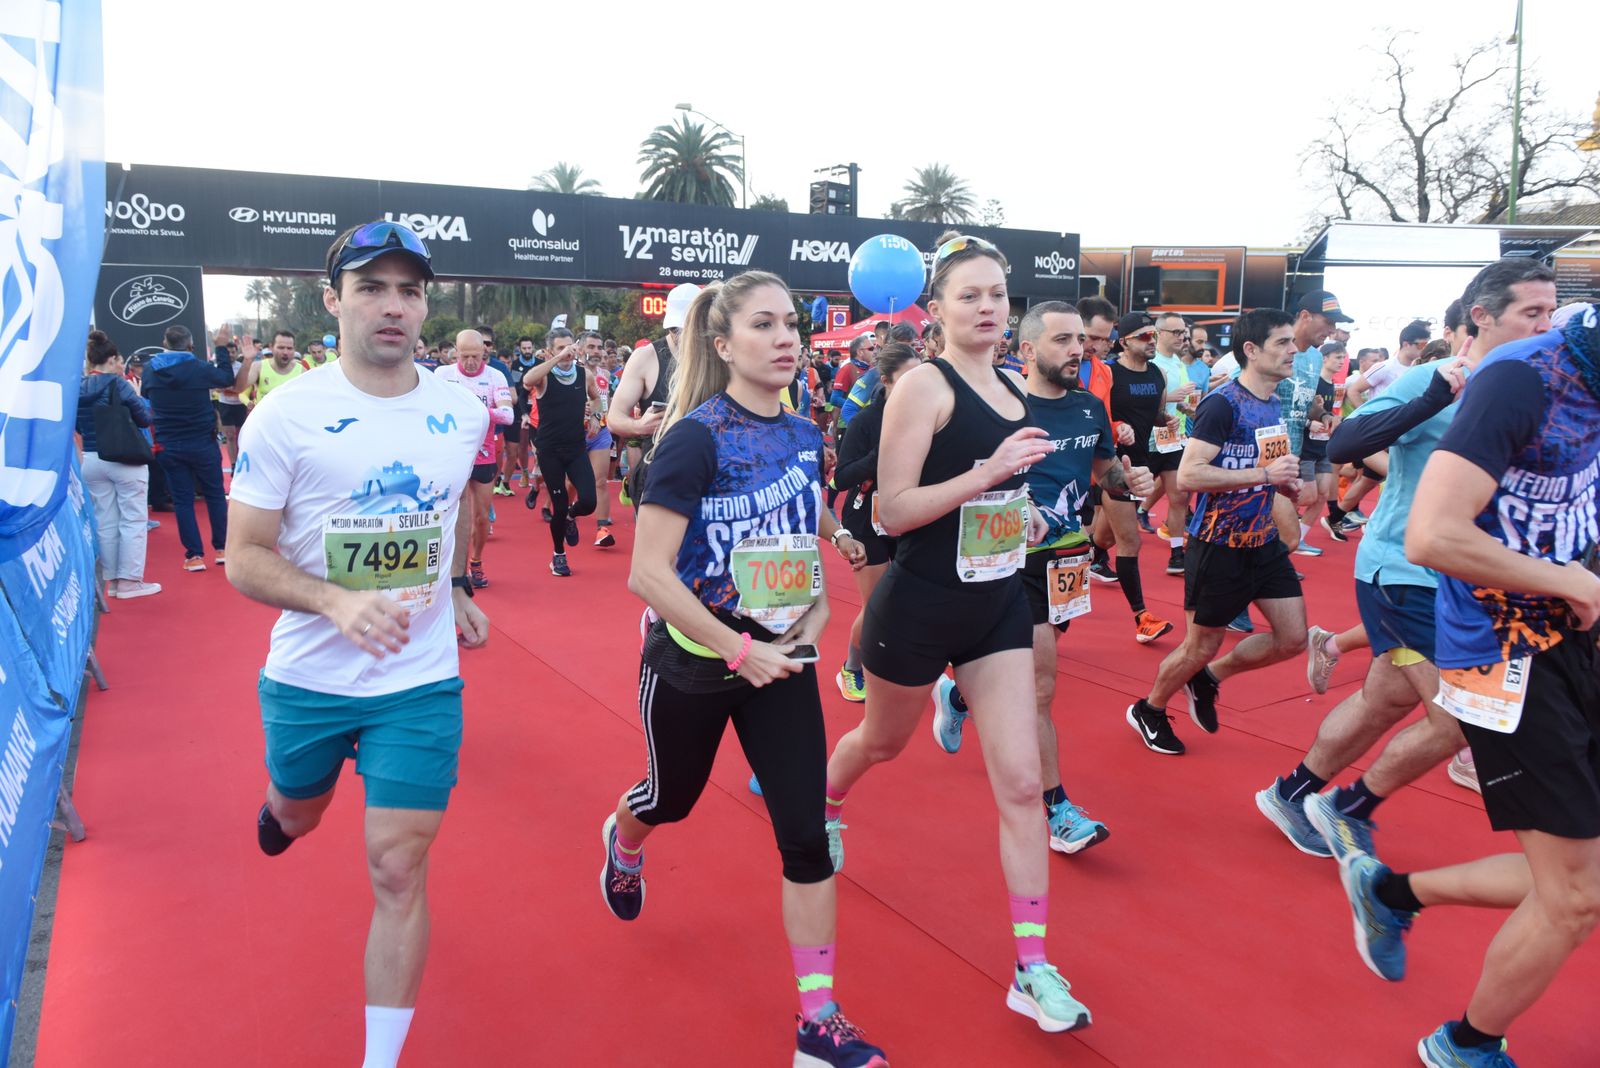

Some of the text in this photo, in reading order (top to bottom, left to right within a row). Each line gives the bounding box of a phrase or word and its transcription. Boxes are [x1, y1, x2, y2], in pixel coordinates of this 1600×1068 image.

[263, 210, 336, 225] HYUNDAI
[263, 225, 336, 235] Hyundauto Motor
[647, 226, 738, 248] maratón
[790, 239, 850, 263] HOKA
[880, 236, 909, 250] 1:50
[514, 253, 574, 263] Healthcare Partner
[671, 245, 741, 265] sevilla
[659, 267, 724, 279] 28 enero 2024
[1129, 383, 1158, 395] MARVEL
[1222, 441, 1254, 457] MEDIO
[1265, 440, 1287, 460] 5233
[701, 465, 809, 520] MEDIO MARATÓN
[1500, 466, 1568, 502] MEDIO
[331, 513, 430, 529] MEDIO MARATÓN SEVILLA
[975, 507, 1021, 541] 7069
[343, 539, 419, 573] 7492
[747, 559, 807, 591] 7068
